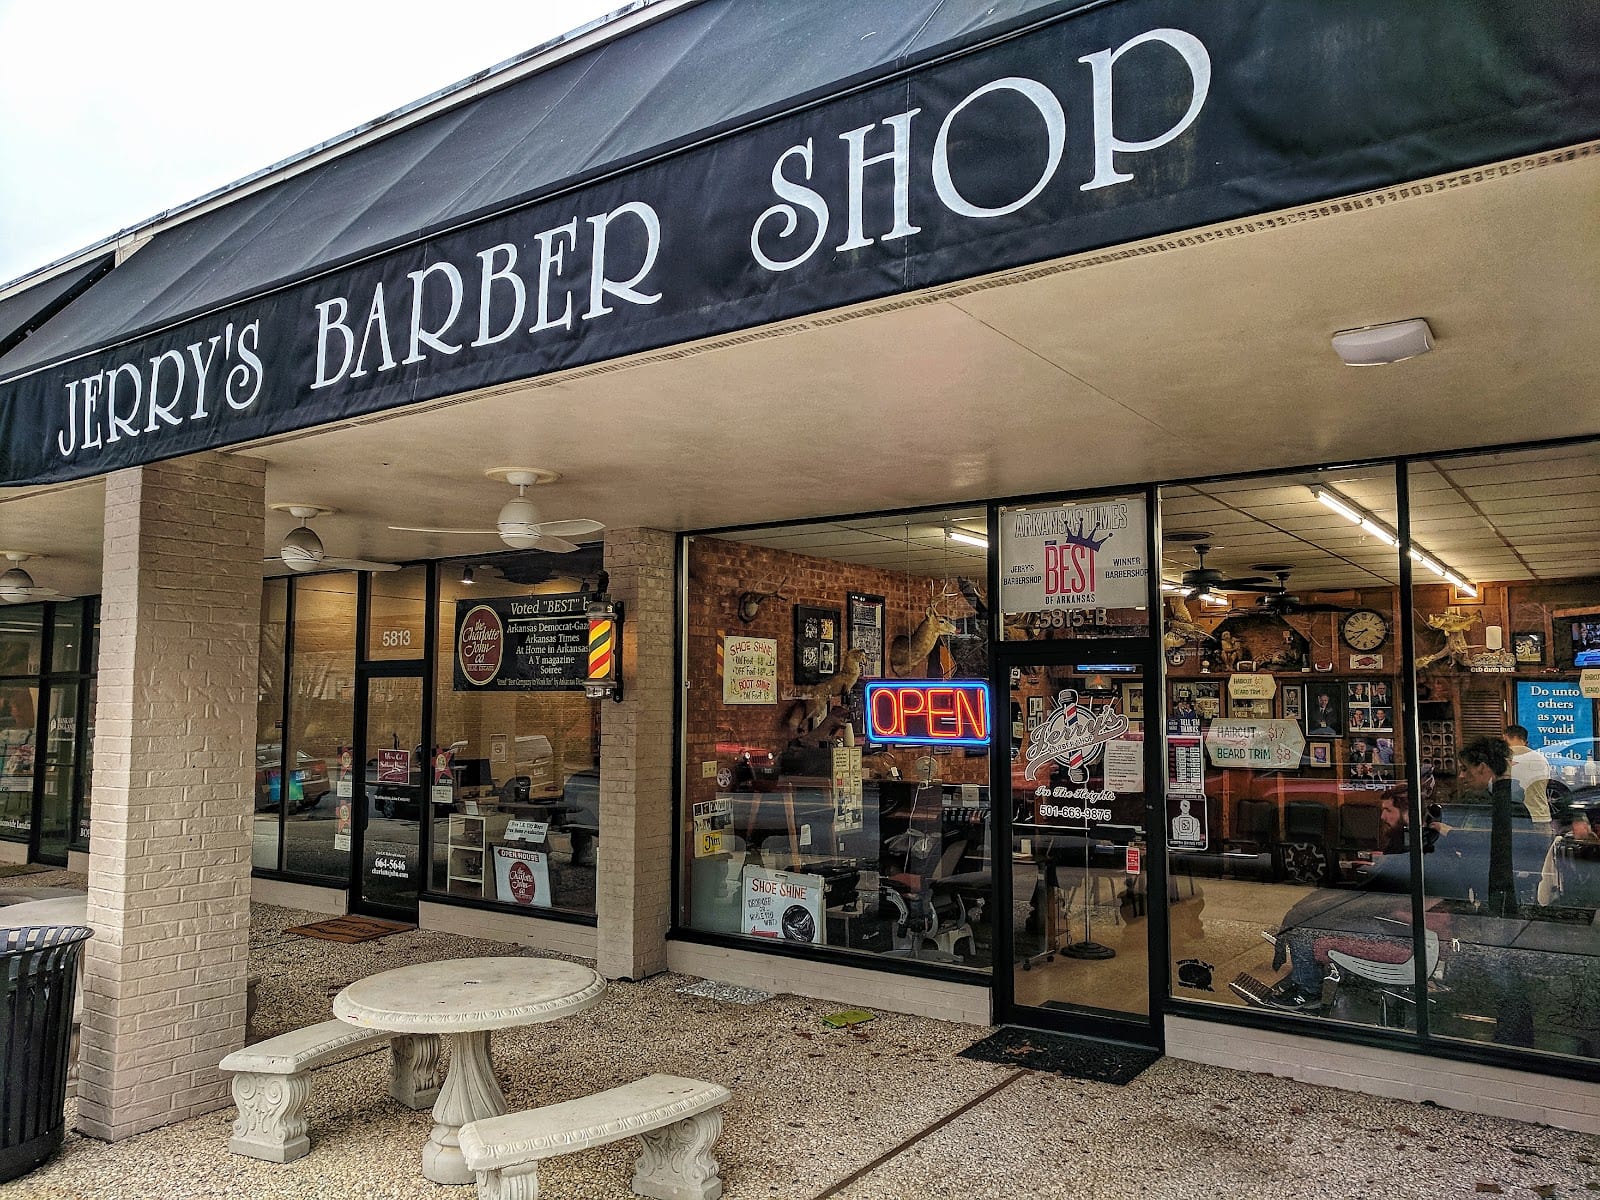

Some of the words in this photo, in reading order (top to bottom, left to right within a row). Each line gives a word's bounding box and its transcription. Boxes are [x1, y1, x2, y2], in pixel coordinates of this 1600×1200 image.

[57, 318, 265, 457] JERRY'S
[310, 201, 663, 390] BARBER
[750, 28, 1211, 272] SHOP
[1015, 508, 1083, 538] ARKANSAS
[1086, 504, 1127, 531] TIMES
[1113, 557, 1141, 567] WINNER
[1010, 564, 1035, 573] JERRY'S
[1045, 544, 1096, 594] BEST
[1105, 570, 1148, 579] BARBERSHOP
[1003, 576, 1042, 586] BARBERSHOP
[1045, 596, 1054, 605] OF
[1057, 594, 1096, 604] ARKANSAS
[510, 600, 540, 616] Voted
[543, 598, 580, 613] "BEST"
[1040, 607, 1107, 629] 5815-B
[475, 619, 485, 631] the
[507, 624, 538, 634] Arkansas
[382, 630, 411, 647] 5813
[463, 626, 500, 642] Charlotte
[525, 634, 557, 644] Arkansas
[558, 633, 580, 643] Times
[464, 639, 496, 657] John
[516, 645, 525, 655] At
[526, 645, 546, 654] Home
[547, 644, 555, 653] in
[556, 643, 589, 653] Arkansas
[730, 641, 751, 656] SHOE
[542, 655, 575, 666] magazine
[1530, 686, 1549, 696] Do
[1552, 687, 1580, 696] unto
[1537, 698, 1574, 709] others
[871, 688, 985, 739] OPEN
[1537, 713, 1549, 721] as
[1552, 713, 1574, 723] you
[1025, 705, 1128, 762] Jerry's
[1217, 726, 1257, 739] HAIRCUT
[1268, 723, 1285, 741] $17
[1537, 724, 1575, 734] would
[1543, 736, 1570, 746] have
[1217, 748, 1246, 759] BEARD
[1248, 748, 1271, 760] TRIM
[1276, 744, 1291, 763] $8
[1566, 749, 1581, 760] do
[1035, 786, 1051, 797] In
[1053, 786, 1073, 798] The
[1073, 788, 1116, 803] Heights
[1040, 804, 1112, 821] 501-663-9875
[501, 850, 517, 859] OPEN
[518, 852, 539, 862] HOUSE
[374, 858, 406, 871] 664-5646
[752, 879, 777, 895] SHOE
[780, 882, 808, 900] SHINE
